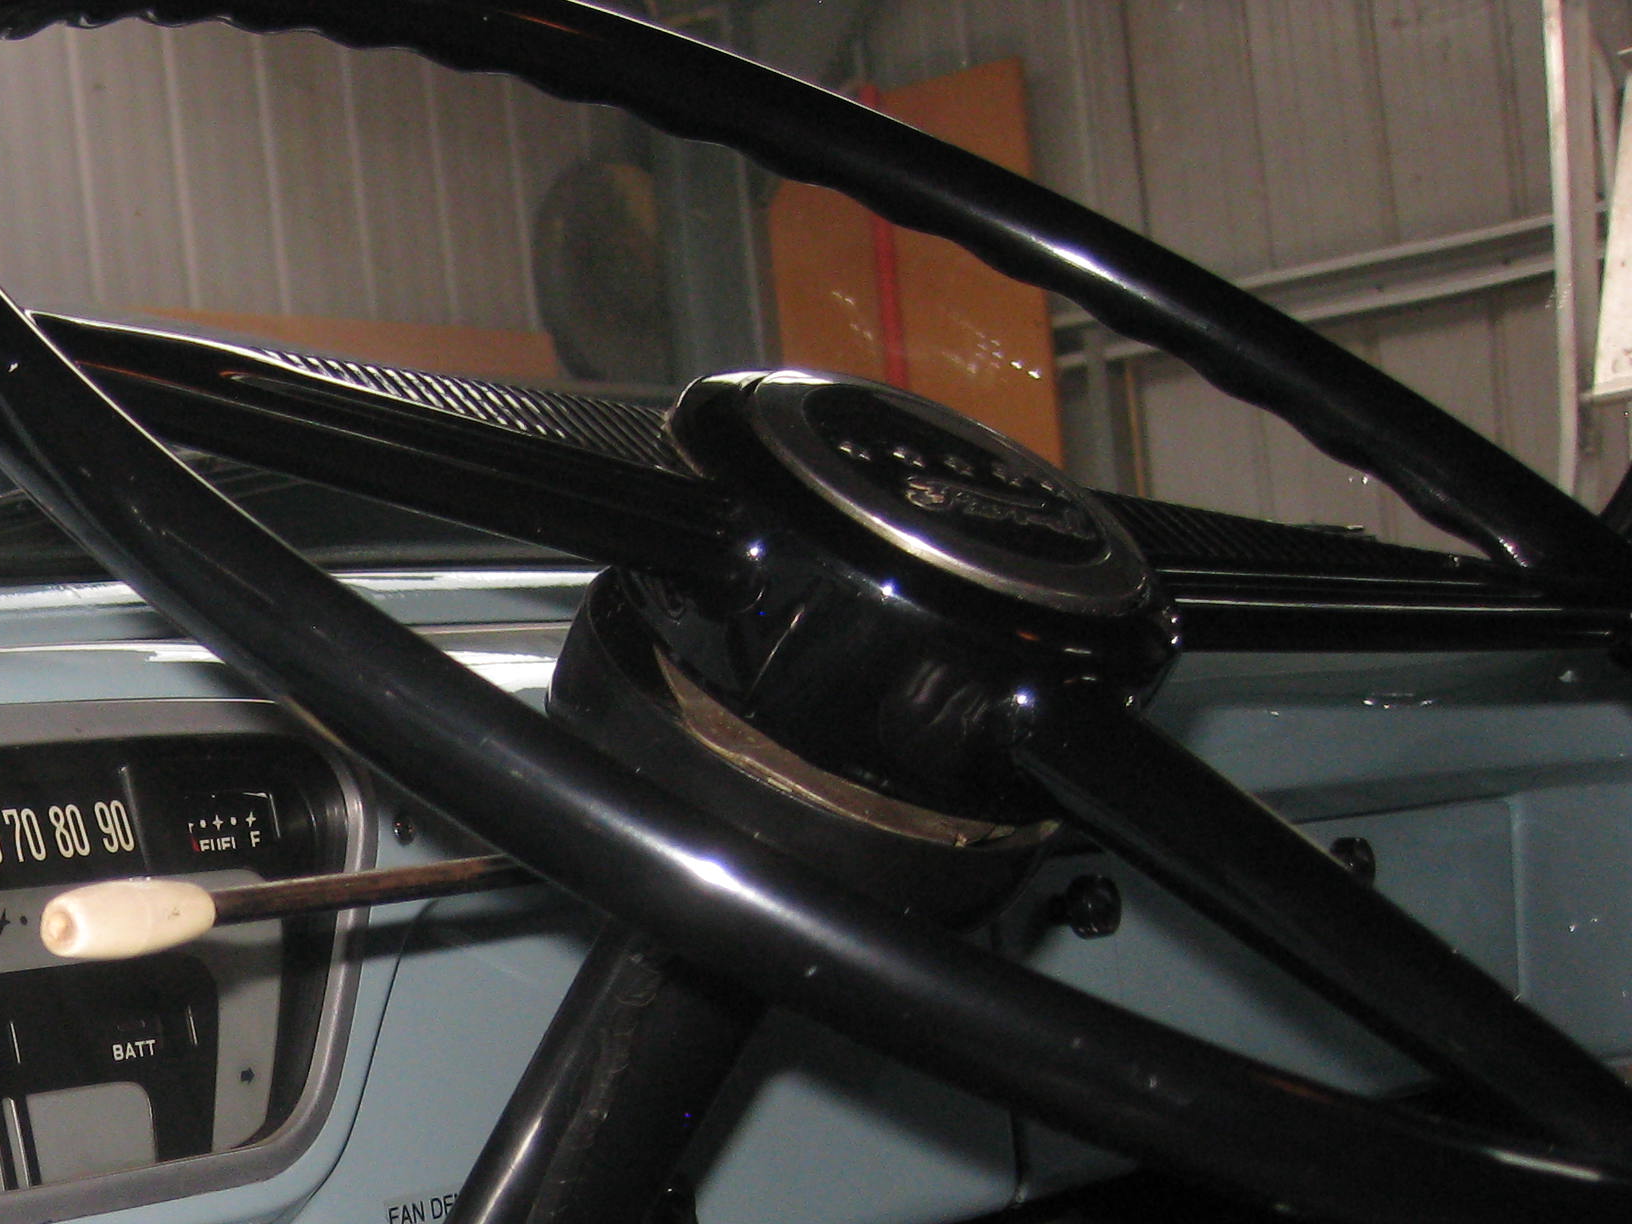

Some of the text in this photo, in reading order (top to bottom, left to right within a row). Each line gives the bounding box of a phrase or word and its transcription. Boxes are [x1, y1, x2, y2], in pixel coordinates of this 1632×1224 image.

[1, 807, 48, 863] 70
[48, 803, 91, 859] 80
[93, 799, 136, 854] 90
[248, 829, 262, 848] F
[112, 1039, 156, 1061] BATT
[430, 1192, 458, 1219] DE
